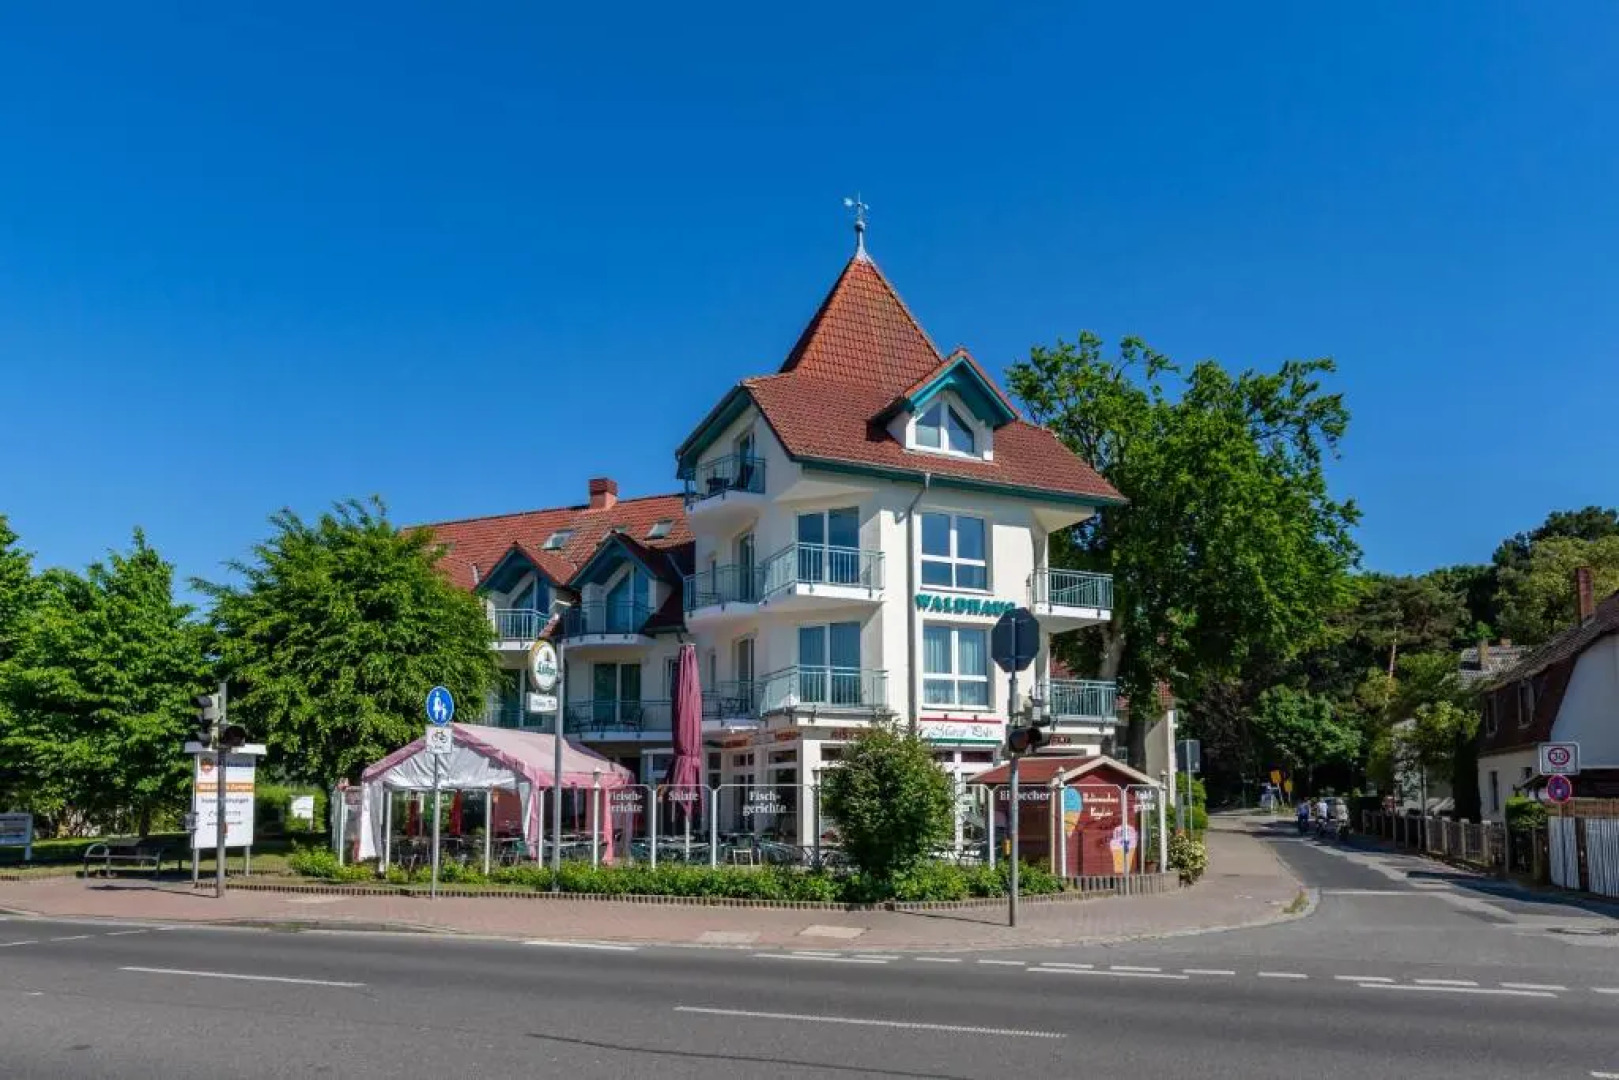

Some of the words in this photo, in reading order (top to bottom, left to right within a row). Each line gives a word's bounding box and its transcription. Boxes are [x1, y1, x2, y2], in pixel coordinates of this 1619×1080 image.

[1551, 752, 1566, 761] 30
[668, 790, 699, 801] Salate
[749, 790, 781, 801] Fisch-
[742, 803, 787, 816] gerichte
